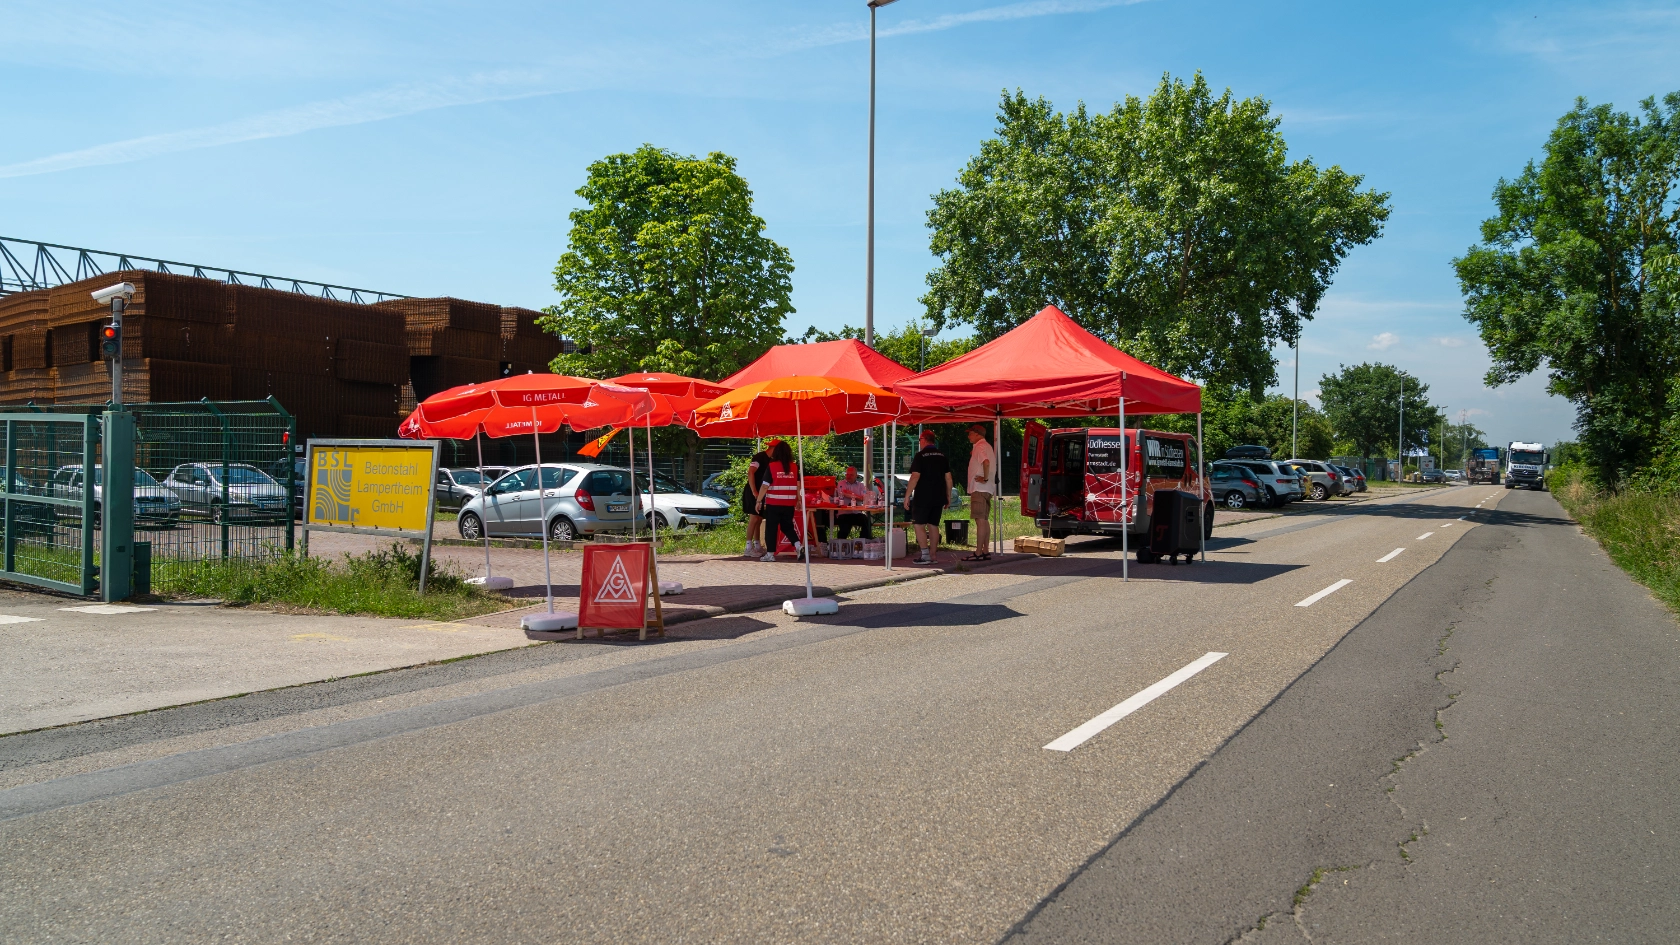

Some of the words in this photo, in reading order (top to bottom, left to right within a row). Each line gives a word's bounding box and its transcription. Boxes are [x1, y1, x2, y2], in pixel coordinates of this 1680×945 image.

[523, 393, 532, 402] IG
[534, 392, 566, 402] METALL
[1147, 440, 1160, 457] WIR
[317, 450, 353, 468] BSL
[364, 461, 418, 476] Betonstahl
[357, 480, 422, 496] Lampertheim
[371, 499, 404, 513] GmbH
